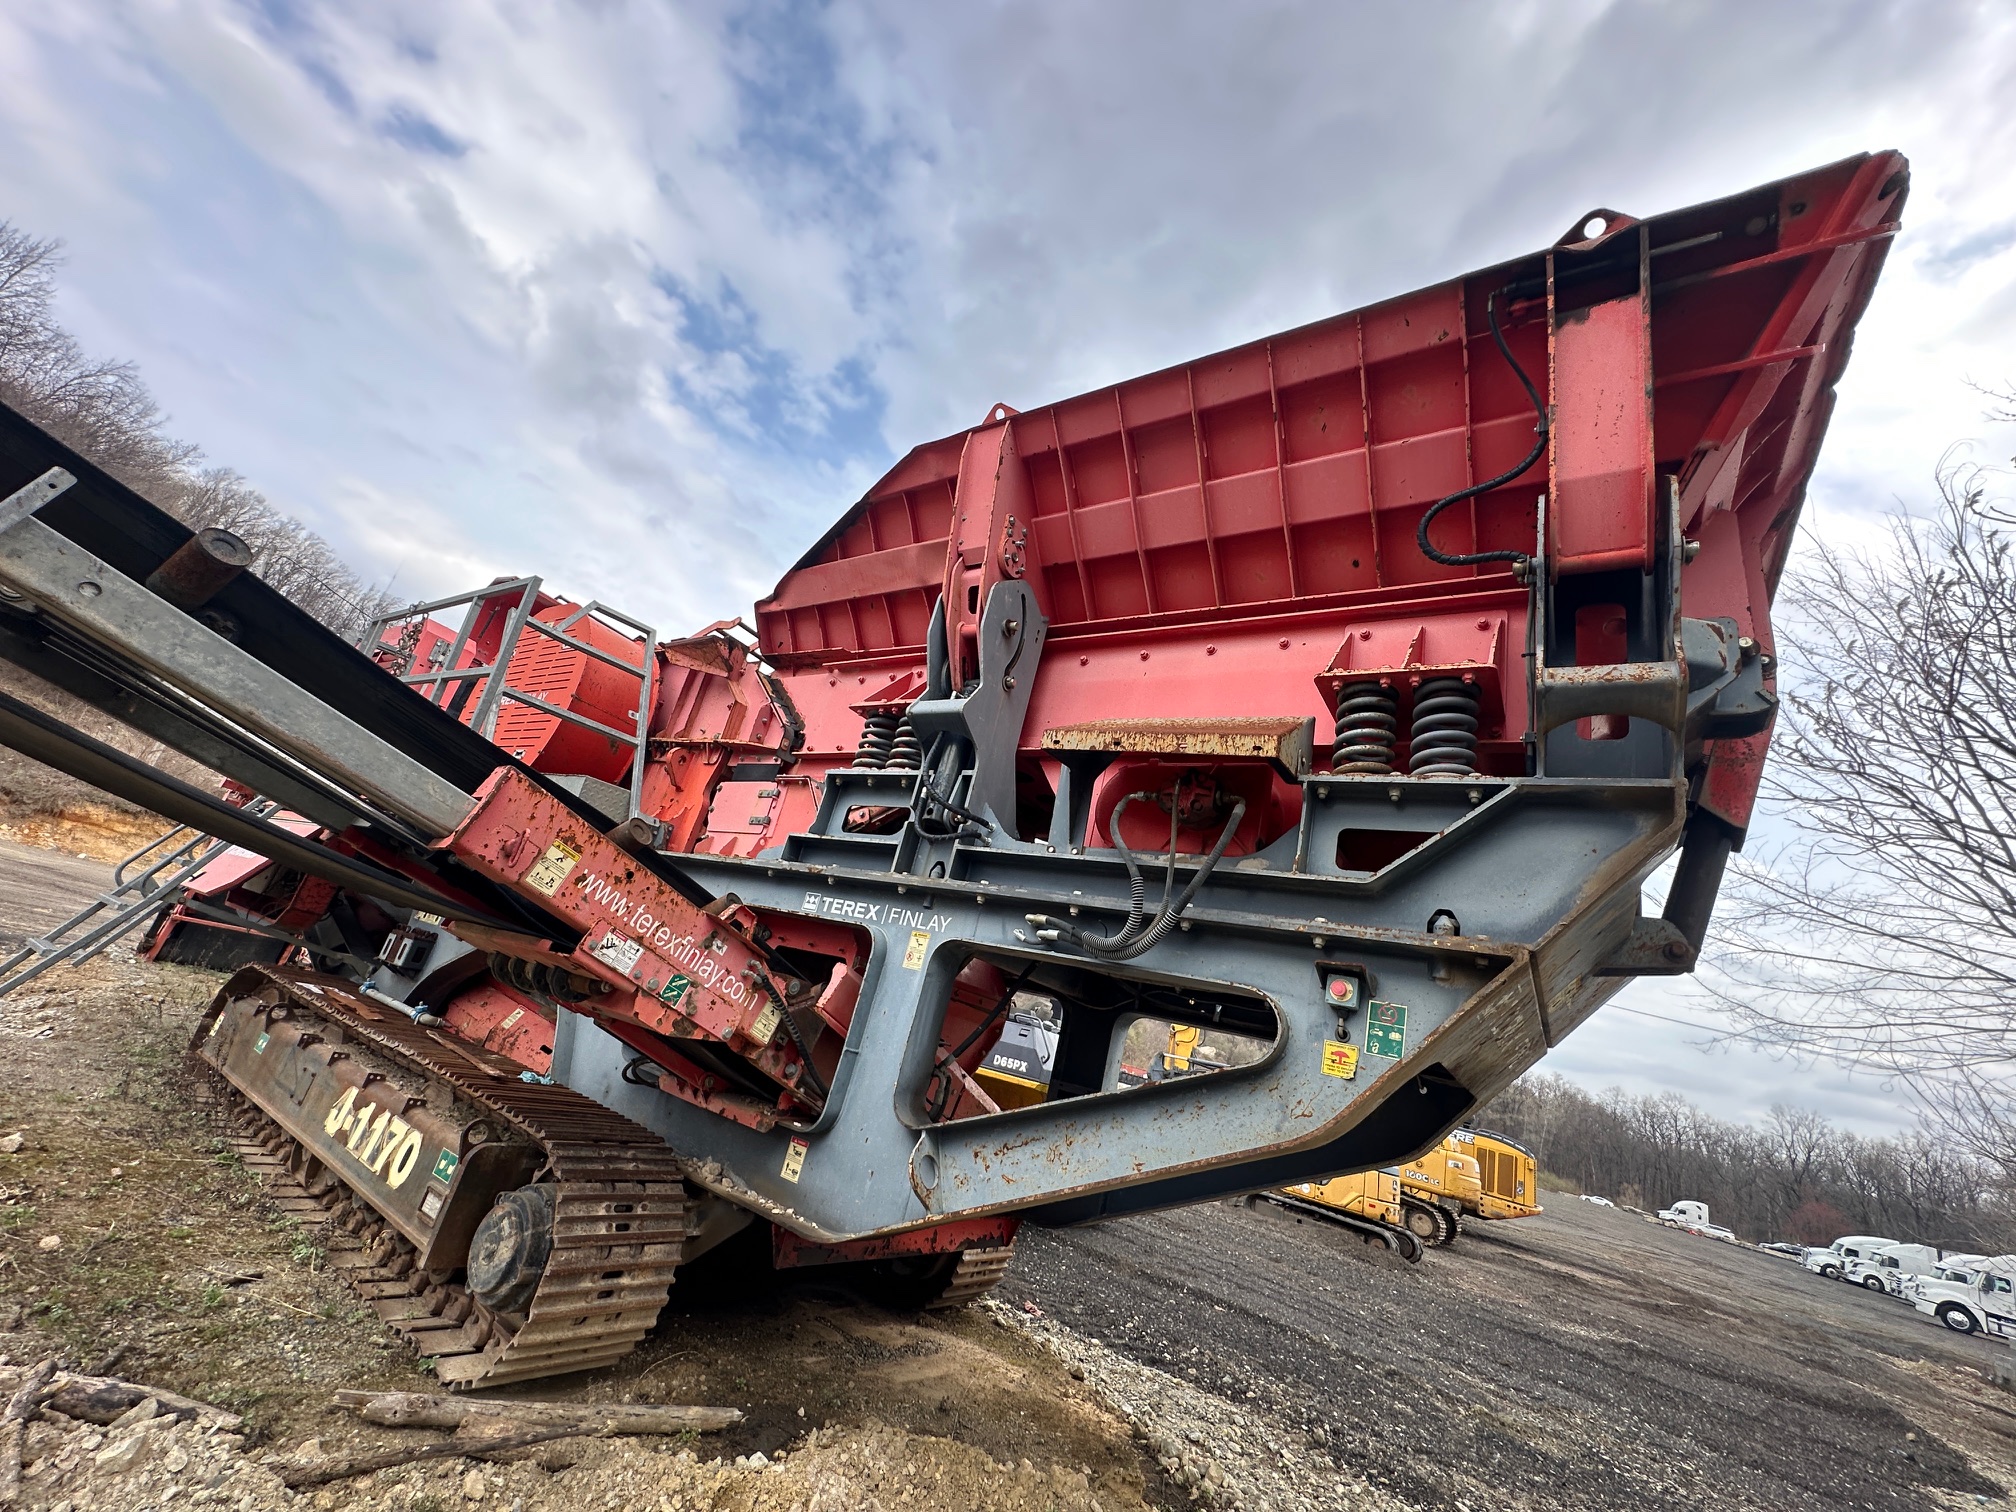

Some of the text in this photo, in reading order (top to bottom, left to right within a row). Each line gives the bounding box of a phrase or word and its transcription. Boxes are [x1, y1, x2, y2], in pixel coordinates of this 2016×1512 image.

[822, 897, 952, 933] TEREX FINLAY
[577, 868, 759, 1011] www.terexfinlay.com
[993, 1054, 1028, 1072] D65PX
[324, 1085, 424, 1190] J-1170
[1405, 1169, 1429, 1183] 160C
